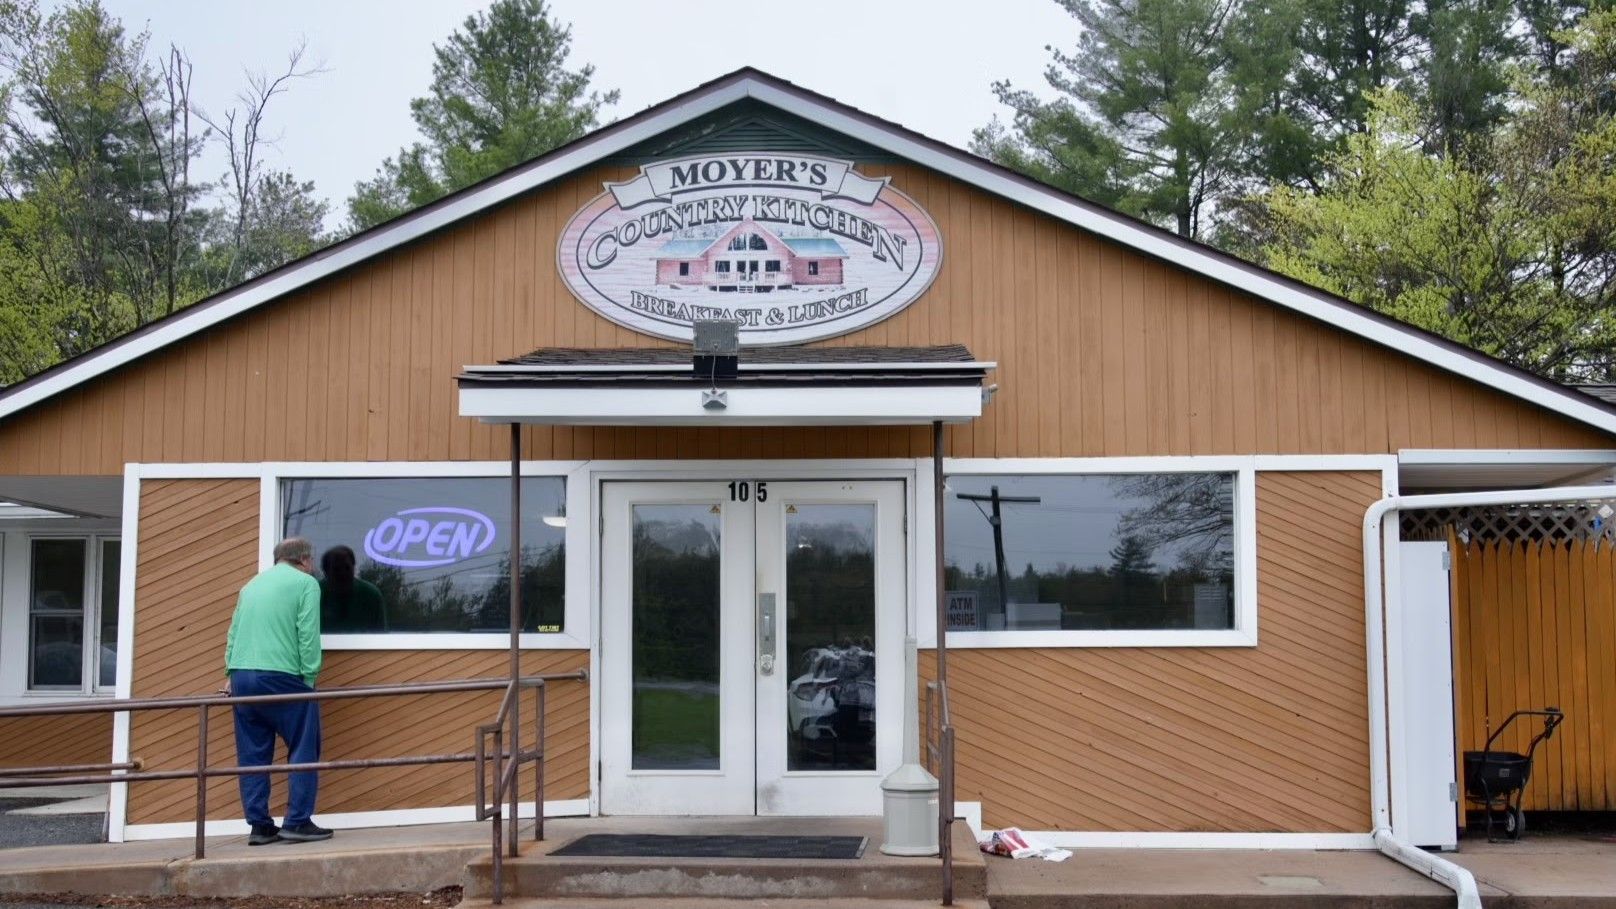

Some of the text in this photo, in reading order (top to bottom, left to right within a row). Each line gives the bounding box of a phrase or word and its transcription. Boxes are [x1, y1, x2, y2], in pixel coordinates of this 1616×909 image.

[670, 157, 828, 189] MOYER'S
[587, 195, 907, 271] COUNTRY KITCHEN
[631, 288, 868, 326] BREAKFAST & LUNCH
[372, 517, 482, 558] OPEN
[946, 613, 976, 626] INSIDE
[950, 597, 972, 610] ATM
